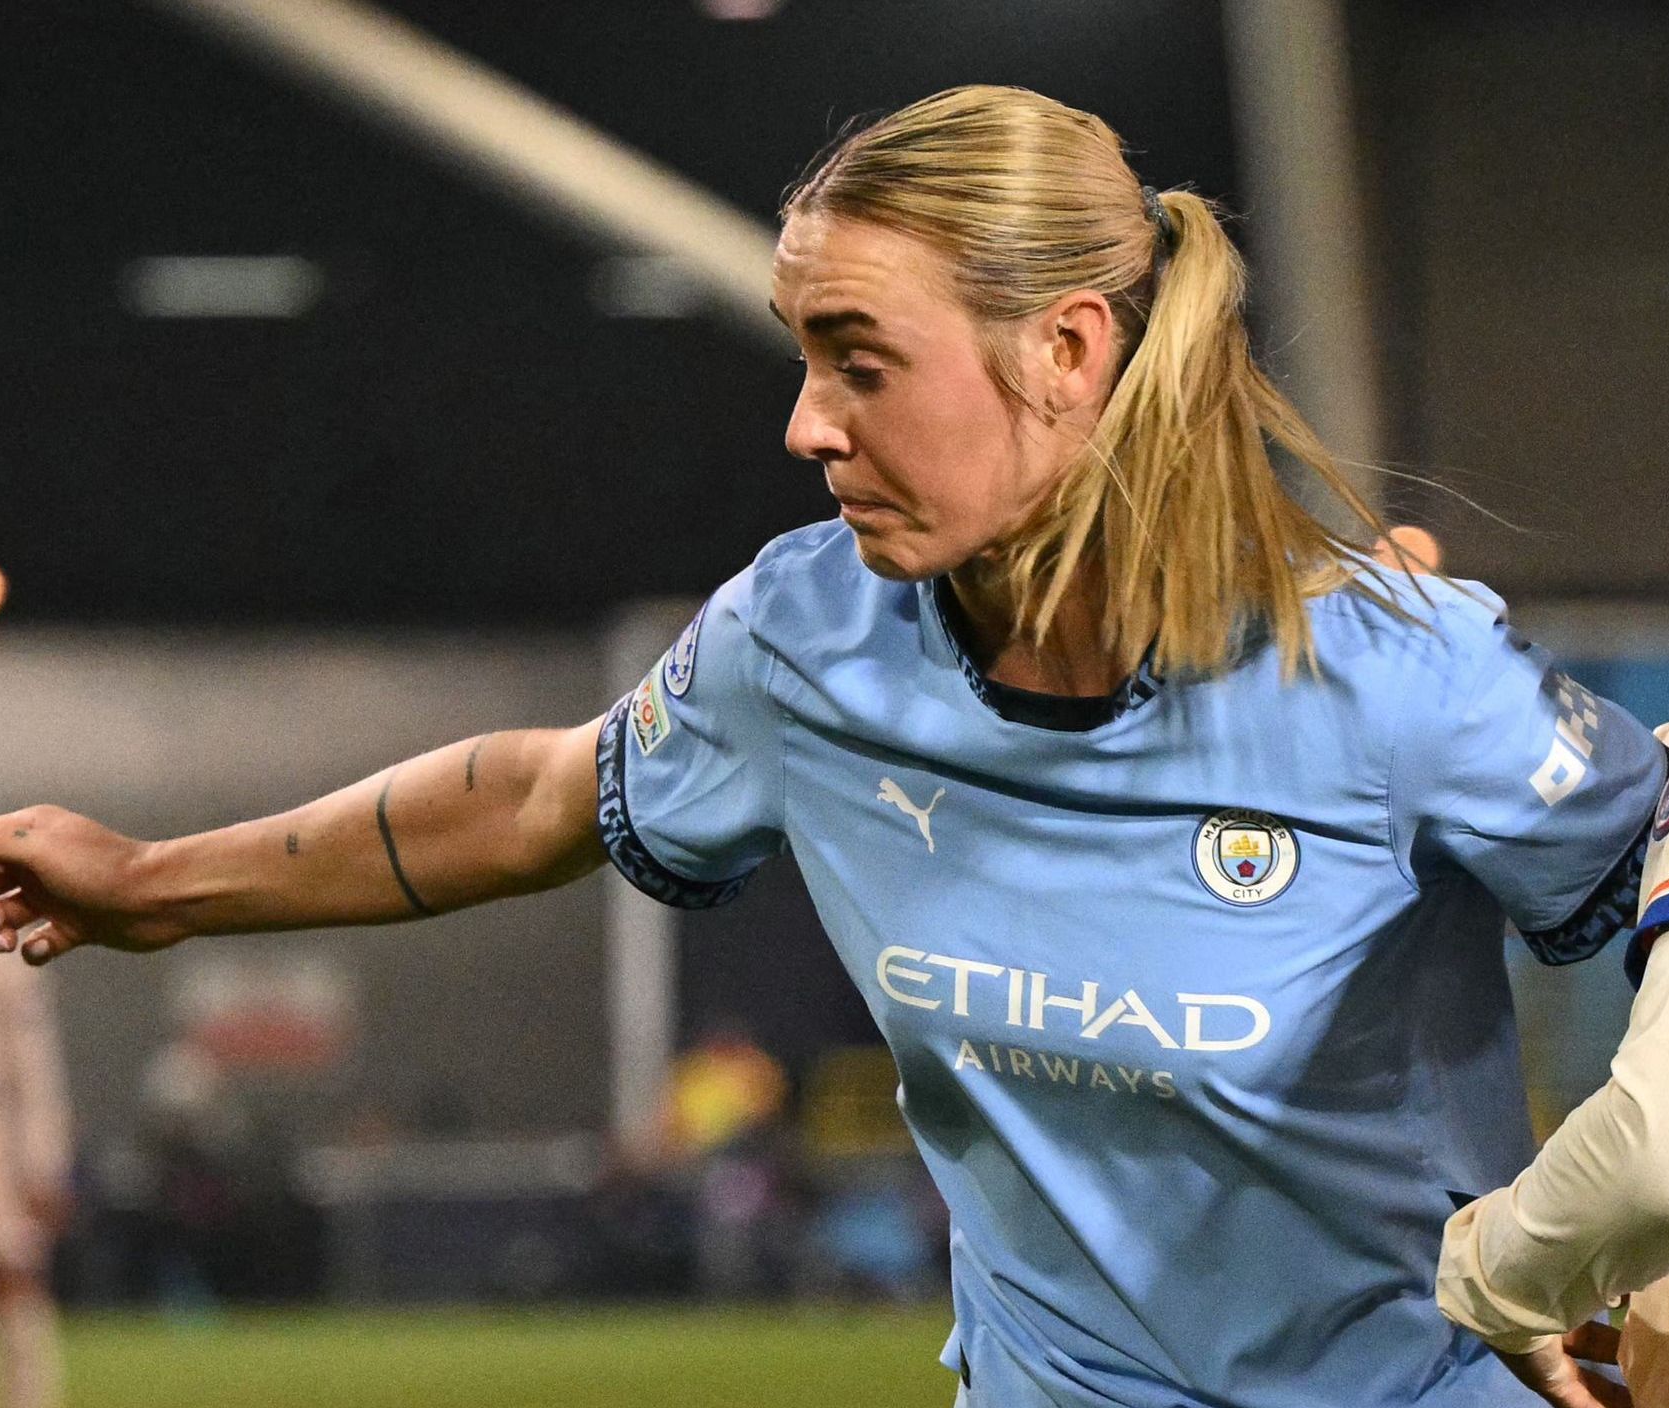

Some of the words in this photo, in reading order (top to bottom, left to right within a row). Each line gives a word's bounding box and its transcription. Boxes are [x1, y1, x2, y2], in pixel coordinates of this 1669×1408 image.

[1232, 888, 1263, 899] CITY
[876, 945, 1271, 1051] ETIHAD
[954, 1038, 1177, 1099] AIRWAYS
